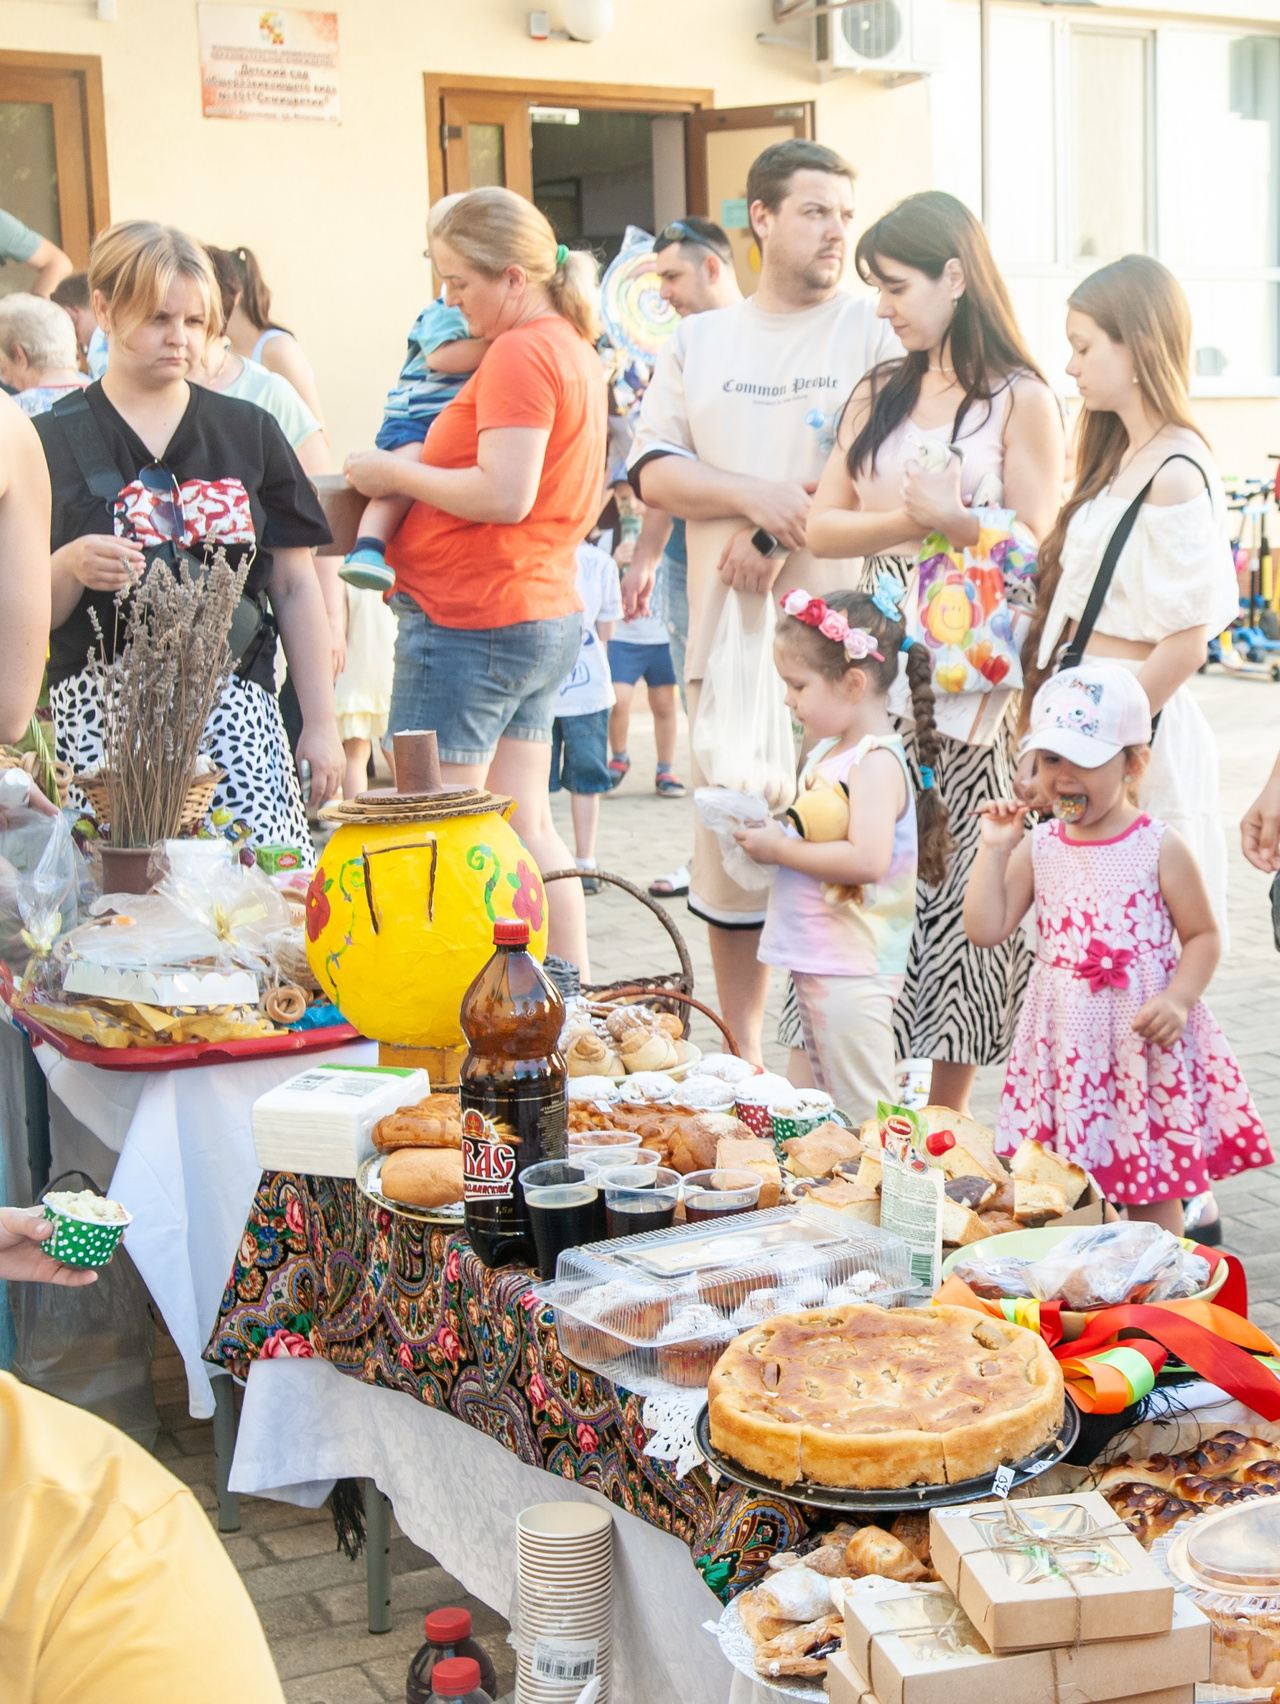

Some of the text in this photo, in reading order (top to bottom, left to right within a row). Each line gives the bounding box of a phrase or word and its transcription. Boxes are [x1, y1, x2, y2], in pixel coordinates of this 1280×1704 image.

[722, 376, 838, 397] Common People
[463, 1140, 514, 1179] ВАС
